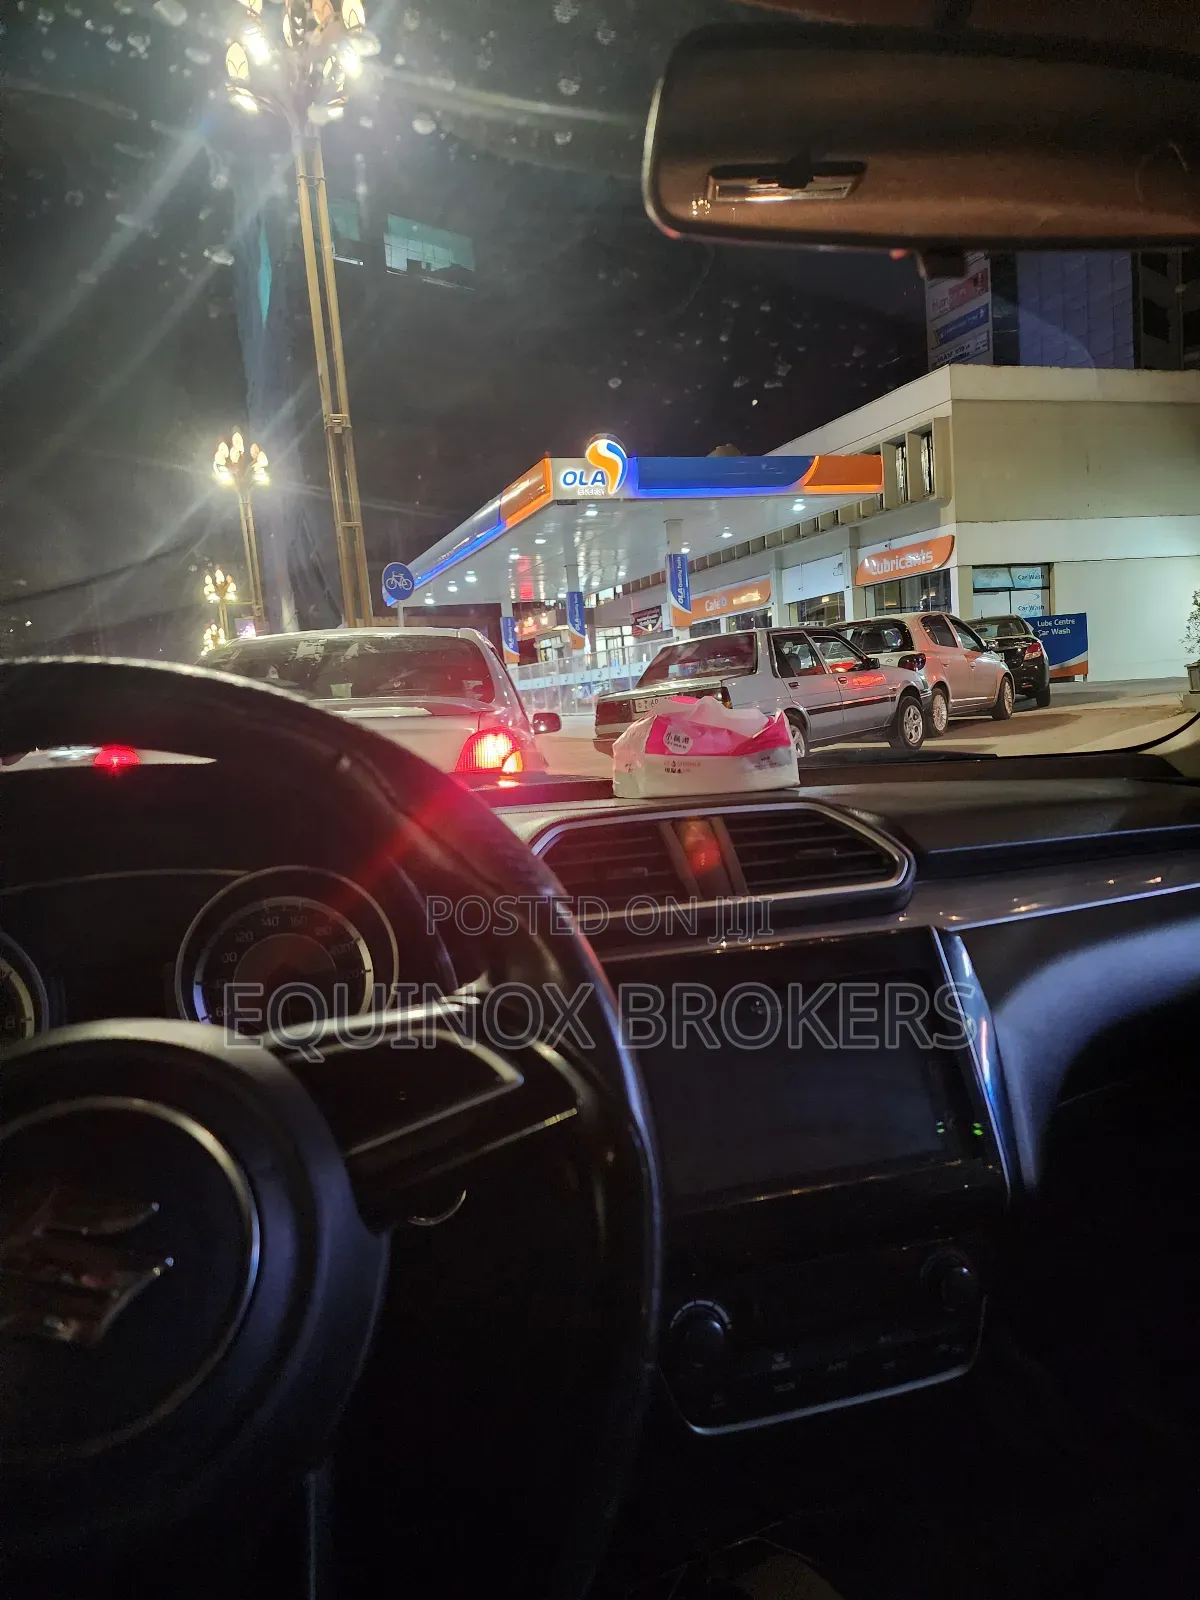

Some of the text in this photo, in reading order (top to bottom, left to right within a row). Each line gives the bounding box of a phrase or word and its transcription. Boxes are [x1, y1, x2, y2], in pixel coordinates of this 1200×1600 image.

[562, 470, 606, 486] OLA
[1037, 618, 1076, 627] Lube Centre
[1038, 629, 1050, 637] Car
